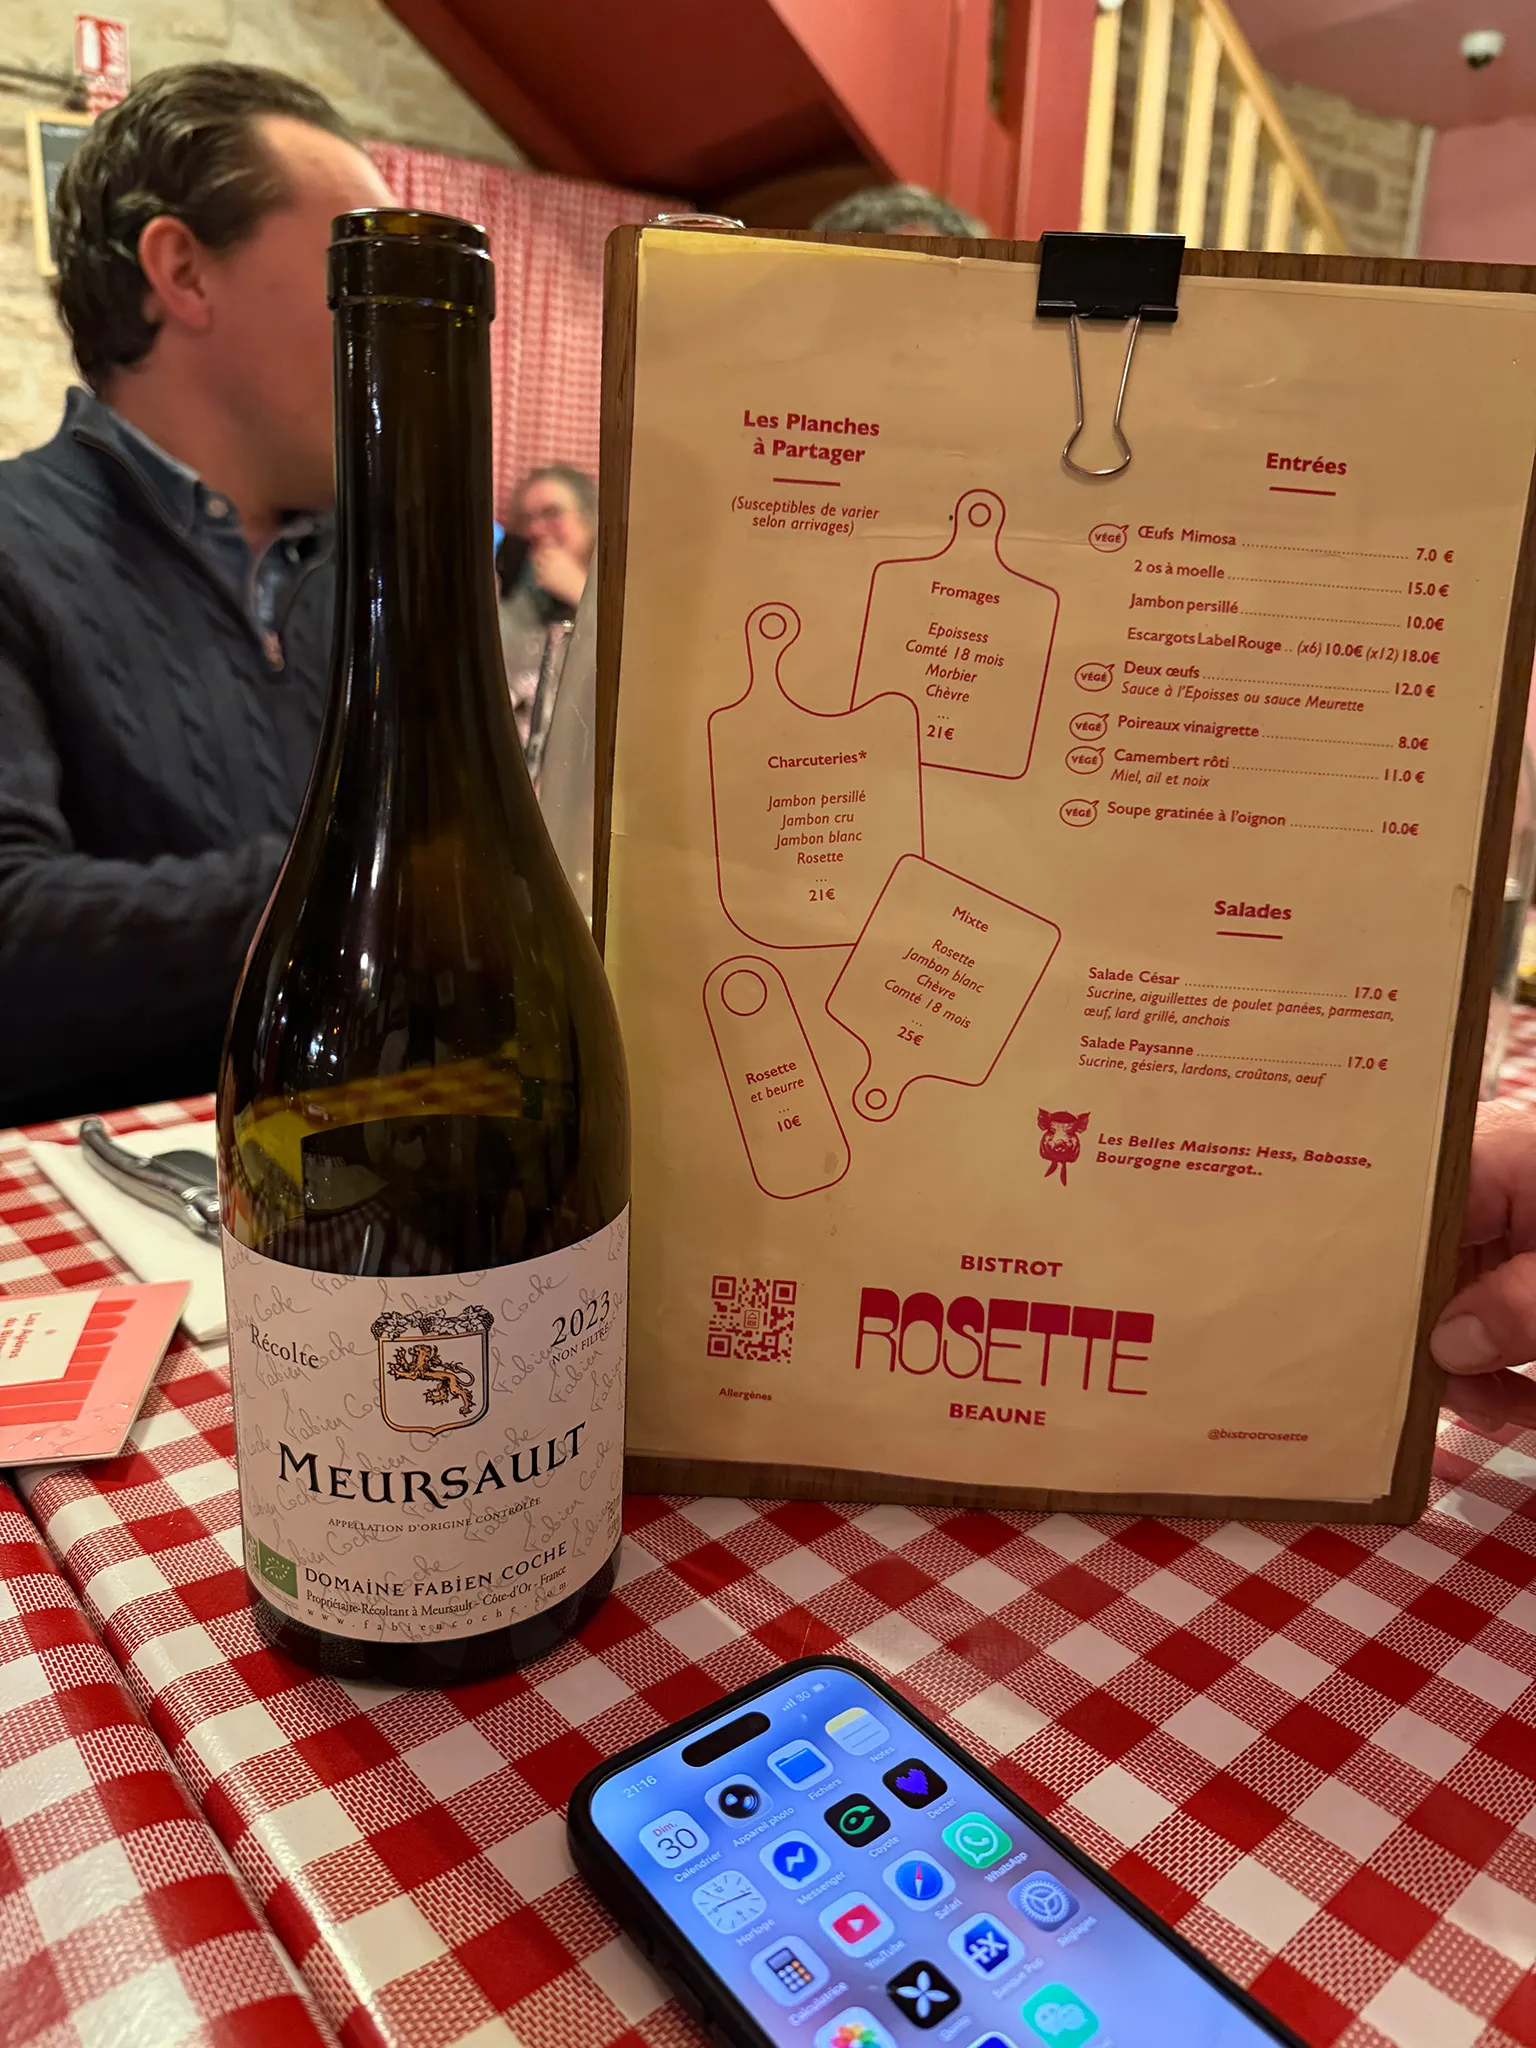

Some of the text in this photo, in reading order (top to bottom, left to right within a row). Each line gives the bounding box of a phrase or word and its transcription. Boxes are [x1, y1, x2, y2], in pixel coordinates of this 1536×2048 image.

[744, 410, 879, 436] Les Planches
[753, 437, 865, 466] à Partager
[1266, 452, 1347, 475] Entrées
[732, 496, 879, 519] (Susceptibles de varier
[752, 514, 854, 537] selon arrivages)
[1095, 533, 1121, 543] VÉGÉ
[1138, 525, 1174, 540] Œufs
[1181, 529, 1236, 545] Mimosa
[1134, 559, 1142, 572] 2
[1146, 564, 1162, 573] os
[1165, 562, 1173, 574] à
[1177, 565, 1224, 579] moelle
[931, 581, 1000, 605] Fromages
[1129, 593, 1444, 631] Jambon persillé 10.0€
[928, 622, 988, 643] Epoissess
[906, 640, 1004, 667] Comté 18 mois
[1128, 627, 1440, 664] Escargots Label Rouge (x6) 10.0€ (x12) 18.0€
[925, 663, 978, 683] Morbier
[1080, 672, 1107, 682] VÉGÉ
[1124, 661, 1162, 676] Deux
[1166, 665, 1200, 678] œufs
[926, 684, 969, 702] Chèvre
[1122, 681, 1159, 696] Sauce
[1164, 685, 1172, 697] à
[1244, 694, 1260, 704] ou
[1264, 695, 1301, 707] sauce
[1305, 696, 1364, 712] Meurette
[927, 724, 954, 740] 21€
[1075, 715, 1429, 751] VÉGÉ Poireaux vinaigrette 8.0€
[1071, 755, 1098, 765] VÉGÉ
[1114, 748, 1200, 766] Camembert
[1203, 756, 1229, 768] rôti
[1110, 769, 1210, 787] Miel, ail et noix
[767, 790, 866, 812] Jambon persillé
[780, 813, 854, 830] Jambon cru
[1065, 801, 1419, 836] VÉGÉ Soupe gratinée à l'oignon 10.0€
[774, 830, 862, 850] Jambon blanc
[797, 851, 843, 864] Rosette
[809, 888, 835, 902] 21€
[952, 906, 989, 932] Mixte
[1214, 900, 1292, 921] Salades
[932, 939, 975, 968] Rosette
[902, 947, 984, 993] Jambon blanc
[1088, 967, 1133, 982] Salade
[1139, 970, 1180, 985] César
[916, 973, 956, 1001] Chèvre
[885, 979, 972, 1029] Comté 18 mois
[1087, 986, 1394, 1022] Sucrine, aiguillettes de poulet panées, parmesan,
[1084, 1006, 1230, 1027] œuf, lard grillé, anchois
[897, 1026, 924, 1046] 25€
[1080, 1035, 1125, 1051] Salade
[1129, 1039, 1193, 1058] Paysanne
[745, 1061, 797, 1085] Rosette
[1079, 1054, 1127, 1072] Sucrine,
[1131, 1059, 1177, 1075] gésiers,
[1181, 1062, 1230, 1079] lardons,
[1235, 1066, 1291, 1084] croûtons,
[751, 1078, 804, 1103] et beurre
[777, 1115, 801, 1132] 10€
[1096, 1151, 1181, 1171] Bourgogne
[1098, 1133, 1372, 1169] Les Belles Maisons: Hess, Bobosse,
[961, 1255, 1063, 1277] BISTROT
[251, 1290, 610, 1369] Récolte 2023
[855, 1287, 1154, 1395] ROSETTE
[552, 1344, 578, 1365] NON
[719, 1388, 772, 1401] Allergènes
[949, 1403, 1046, 1426] BEAUNE
[1208, 1429, 1308, 1442] @bistrotrosette
[278, 1422, 587, 1509] MEURSAULT
[329, 1518, 404, 1533] APPELLATION
[408, 1517, 471, 1533] D'ORIGINE
[502, 1541, 568, 1580] COCHE
[412, 1606, 418, 1617] à
[421, 1601, 473, 1616] Meursault
[540, 1565, 567, 1586] France
[869, 1745, 895, 1764] Notes
[623, 1775, 658, 1799] 21:16
[808, 1777, 842, 1801] Fichiers
[927, 1797, 957, 1820] Deezer
[653, 1820, 678, 1838] Dim.
[732, 1806, 795, 1848] Appareil photo
[657, 1827, 698, 1860] 30
[868, 1835, 900, 1858] Coyote
[673, 1850, 722, 1883] Calendrier
[984, 1851, 1028, 1883] WhatsApp
[865, 1940, 905, 1970] YouTube
